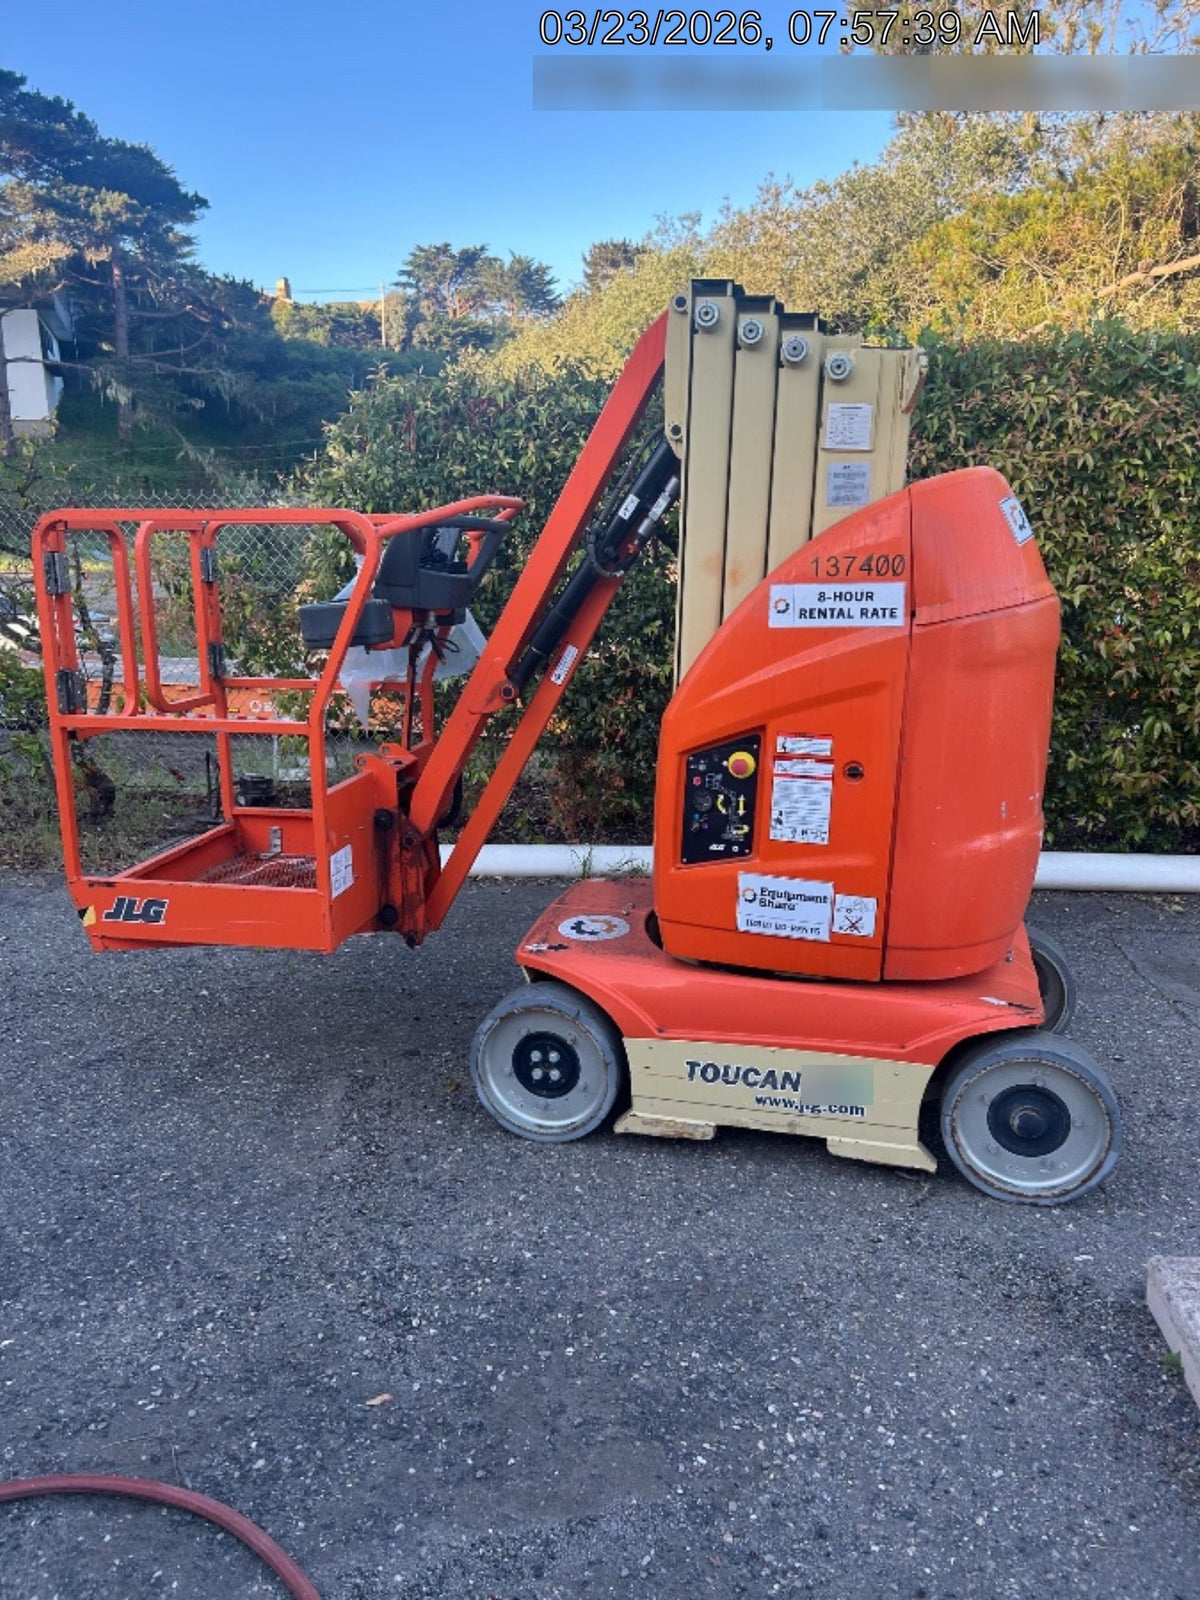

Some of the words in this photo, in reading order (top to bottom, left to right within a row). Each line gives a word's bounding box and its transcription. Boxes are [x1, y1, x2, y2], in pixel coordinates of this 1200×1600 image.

[811, 555, 906, 578] 137400
[817, 591, 875, 603] 8-HOUR
[798, 607, 855, 620] RENTAL
[860, 607, 899, 620] RATE
[758, 897, 797, 911] Share
[760, 886, 829, 904] Equipment
[102, 896, 169, 925] JLG
[685, 1060, 802, 1093] TOUCAN
